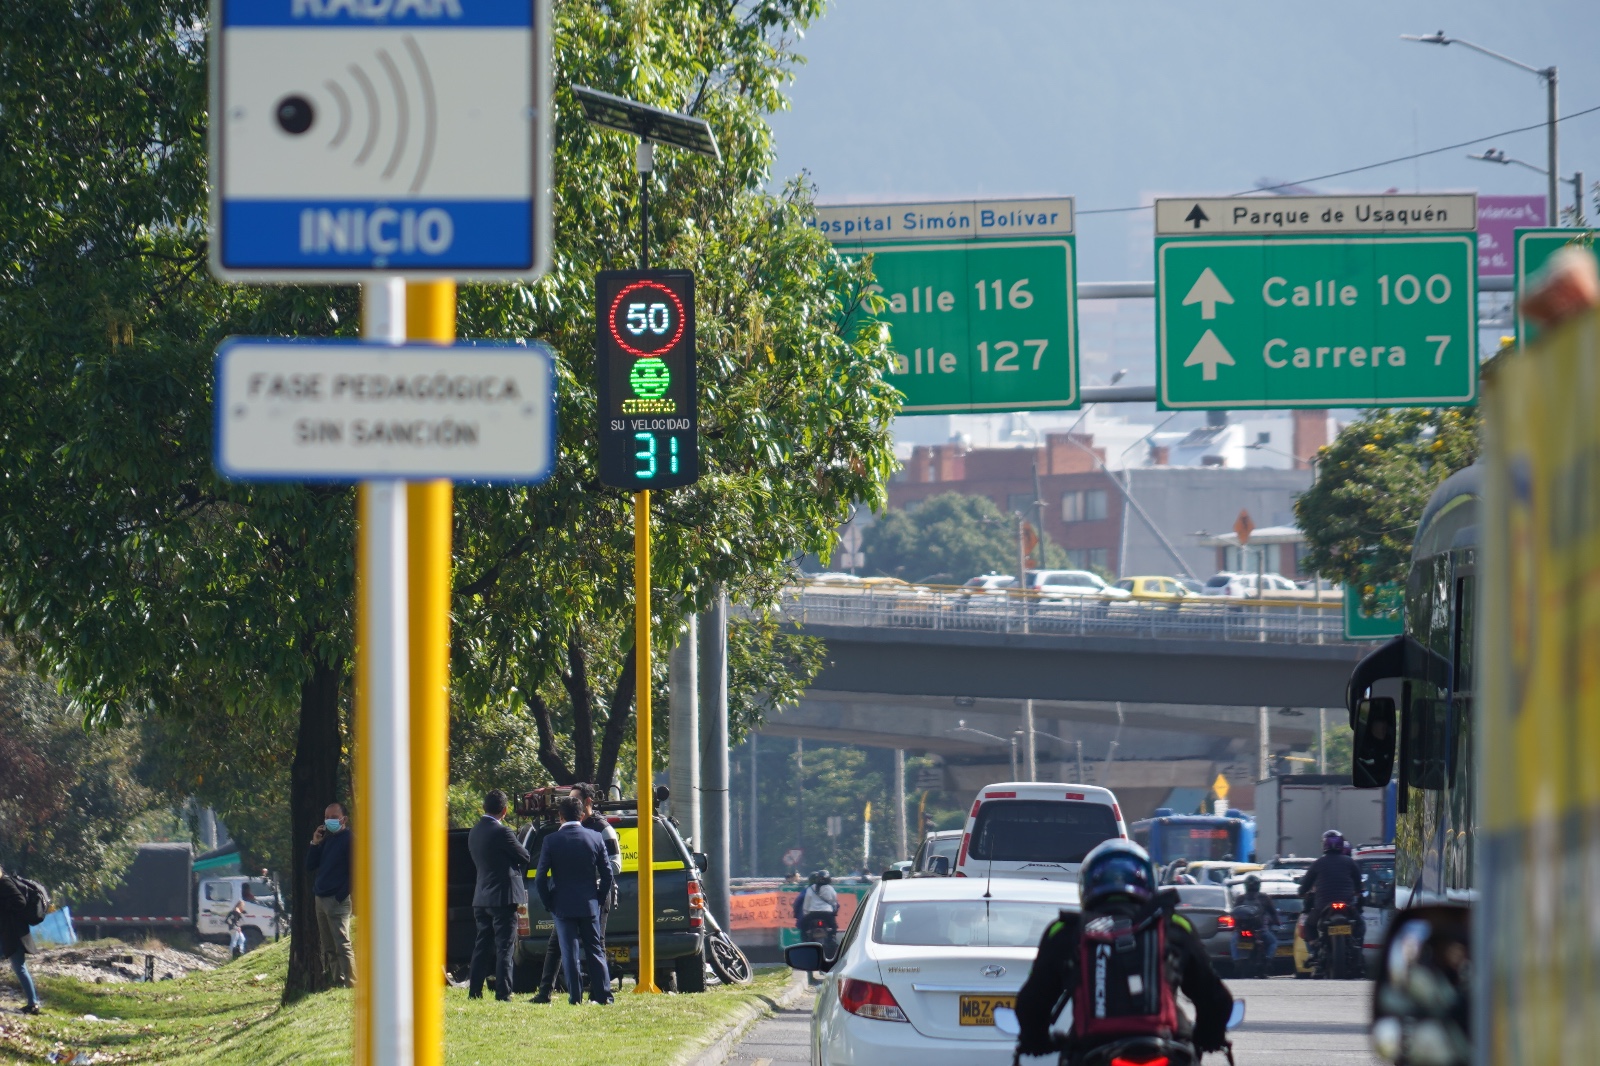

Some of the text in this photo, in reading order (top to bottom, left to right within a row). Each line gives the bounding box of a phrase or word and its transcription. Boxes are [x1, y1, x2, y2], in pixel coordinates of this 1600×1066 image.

[301, 208, 454, 255] INICIO
[903, 211, 970, 230] Simón
[980, 209, 1058, 228] Bolívar
[1233, 204, 1447, 227] Parque de Usaquén
[860, 278, 1034, 314] Calle 116
[1262, 273, 1452, 307] Calle 100
[626, 303, 669, 335] 50
[883, 338, 1049, 374] alle 127
[1262, 334, 1452, 369] Carrera 7
[248, 368, 522, 401] FASE PEDAGÓGICA
[294, 413, 481, 446] SIN SANCIÓN
[611, 418, 690, 431] SU VELOCIDAD
[635, 432, 678, 478] 31
